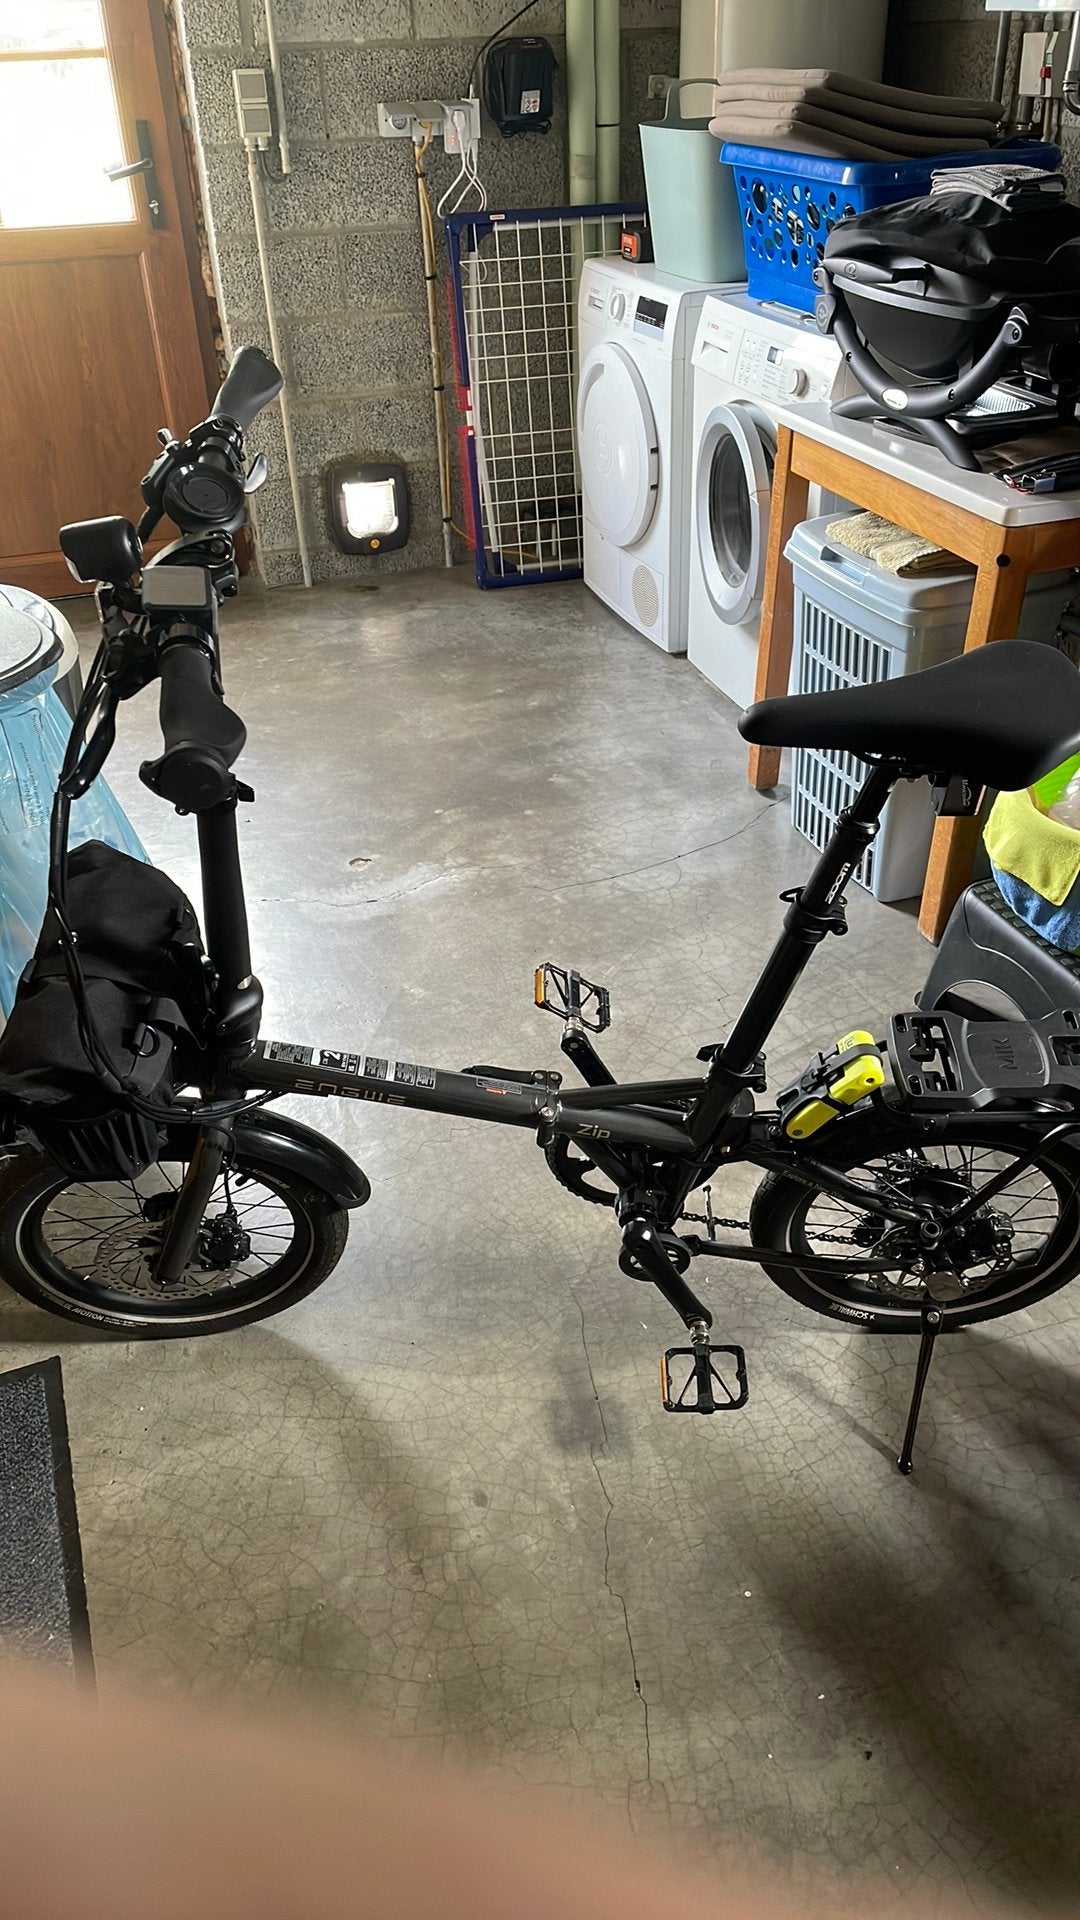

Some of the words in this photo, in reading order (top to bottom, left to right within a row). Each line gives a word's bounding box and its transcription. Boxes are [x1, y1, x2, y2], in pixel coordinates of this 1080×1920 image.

[825, 862, 851, 904] zoom
[295, 1078, 406, 1105] ENGWE
[577, 1123, 611, 1139] Zip
